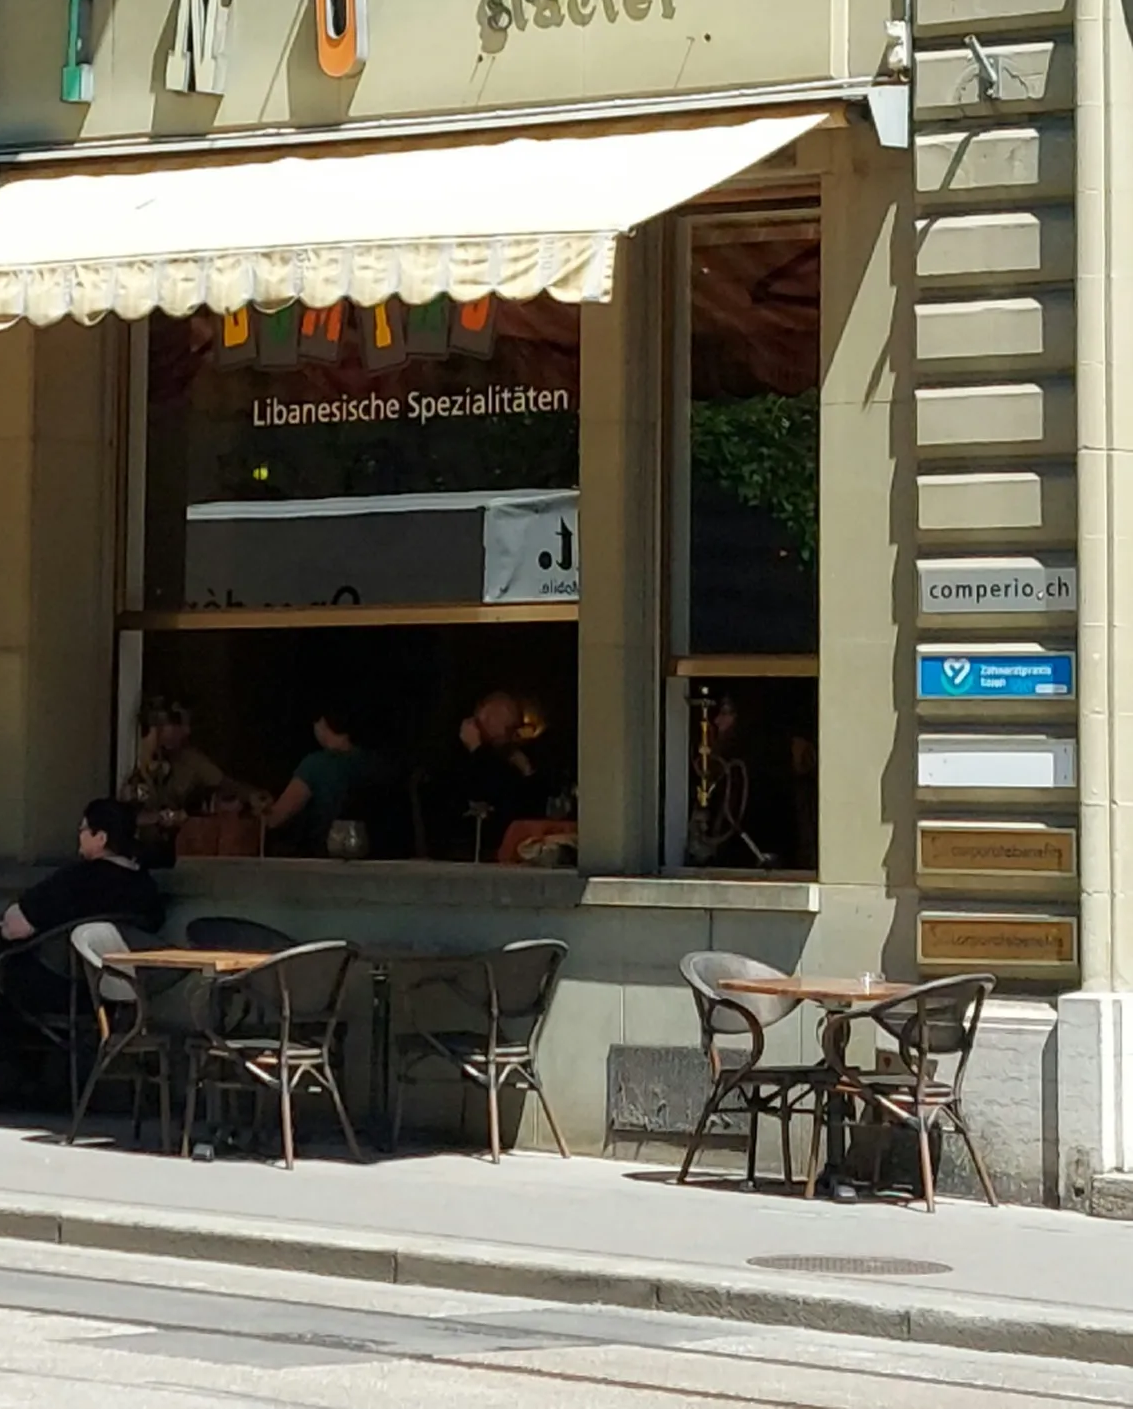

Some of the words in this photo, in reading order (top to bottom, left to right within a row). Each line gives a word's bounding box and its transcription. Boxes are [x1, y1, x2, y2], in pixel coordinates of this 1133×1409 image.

[252, 392, 400, 427] Libanesische
[407, 385, 568, 425] Spezialitäten
[929, 575, 1070, 605] comperio.ch
